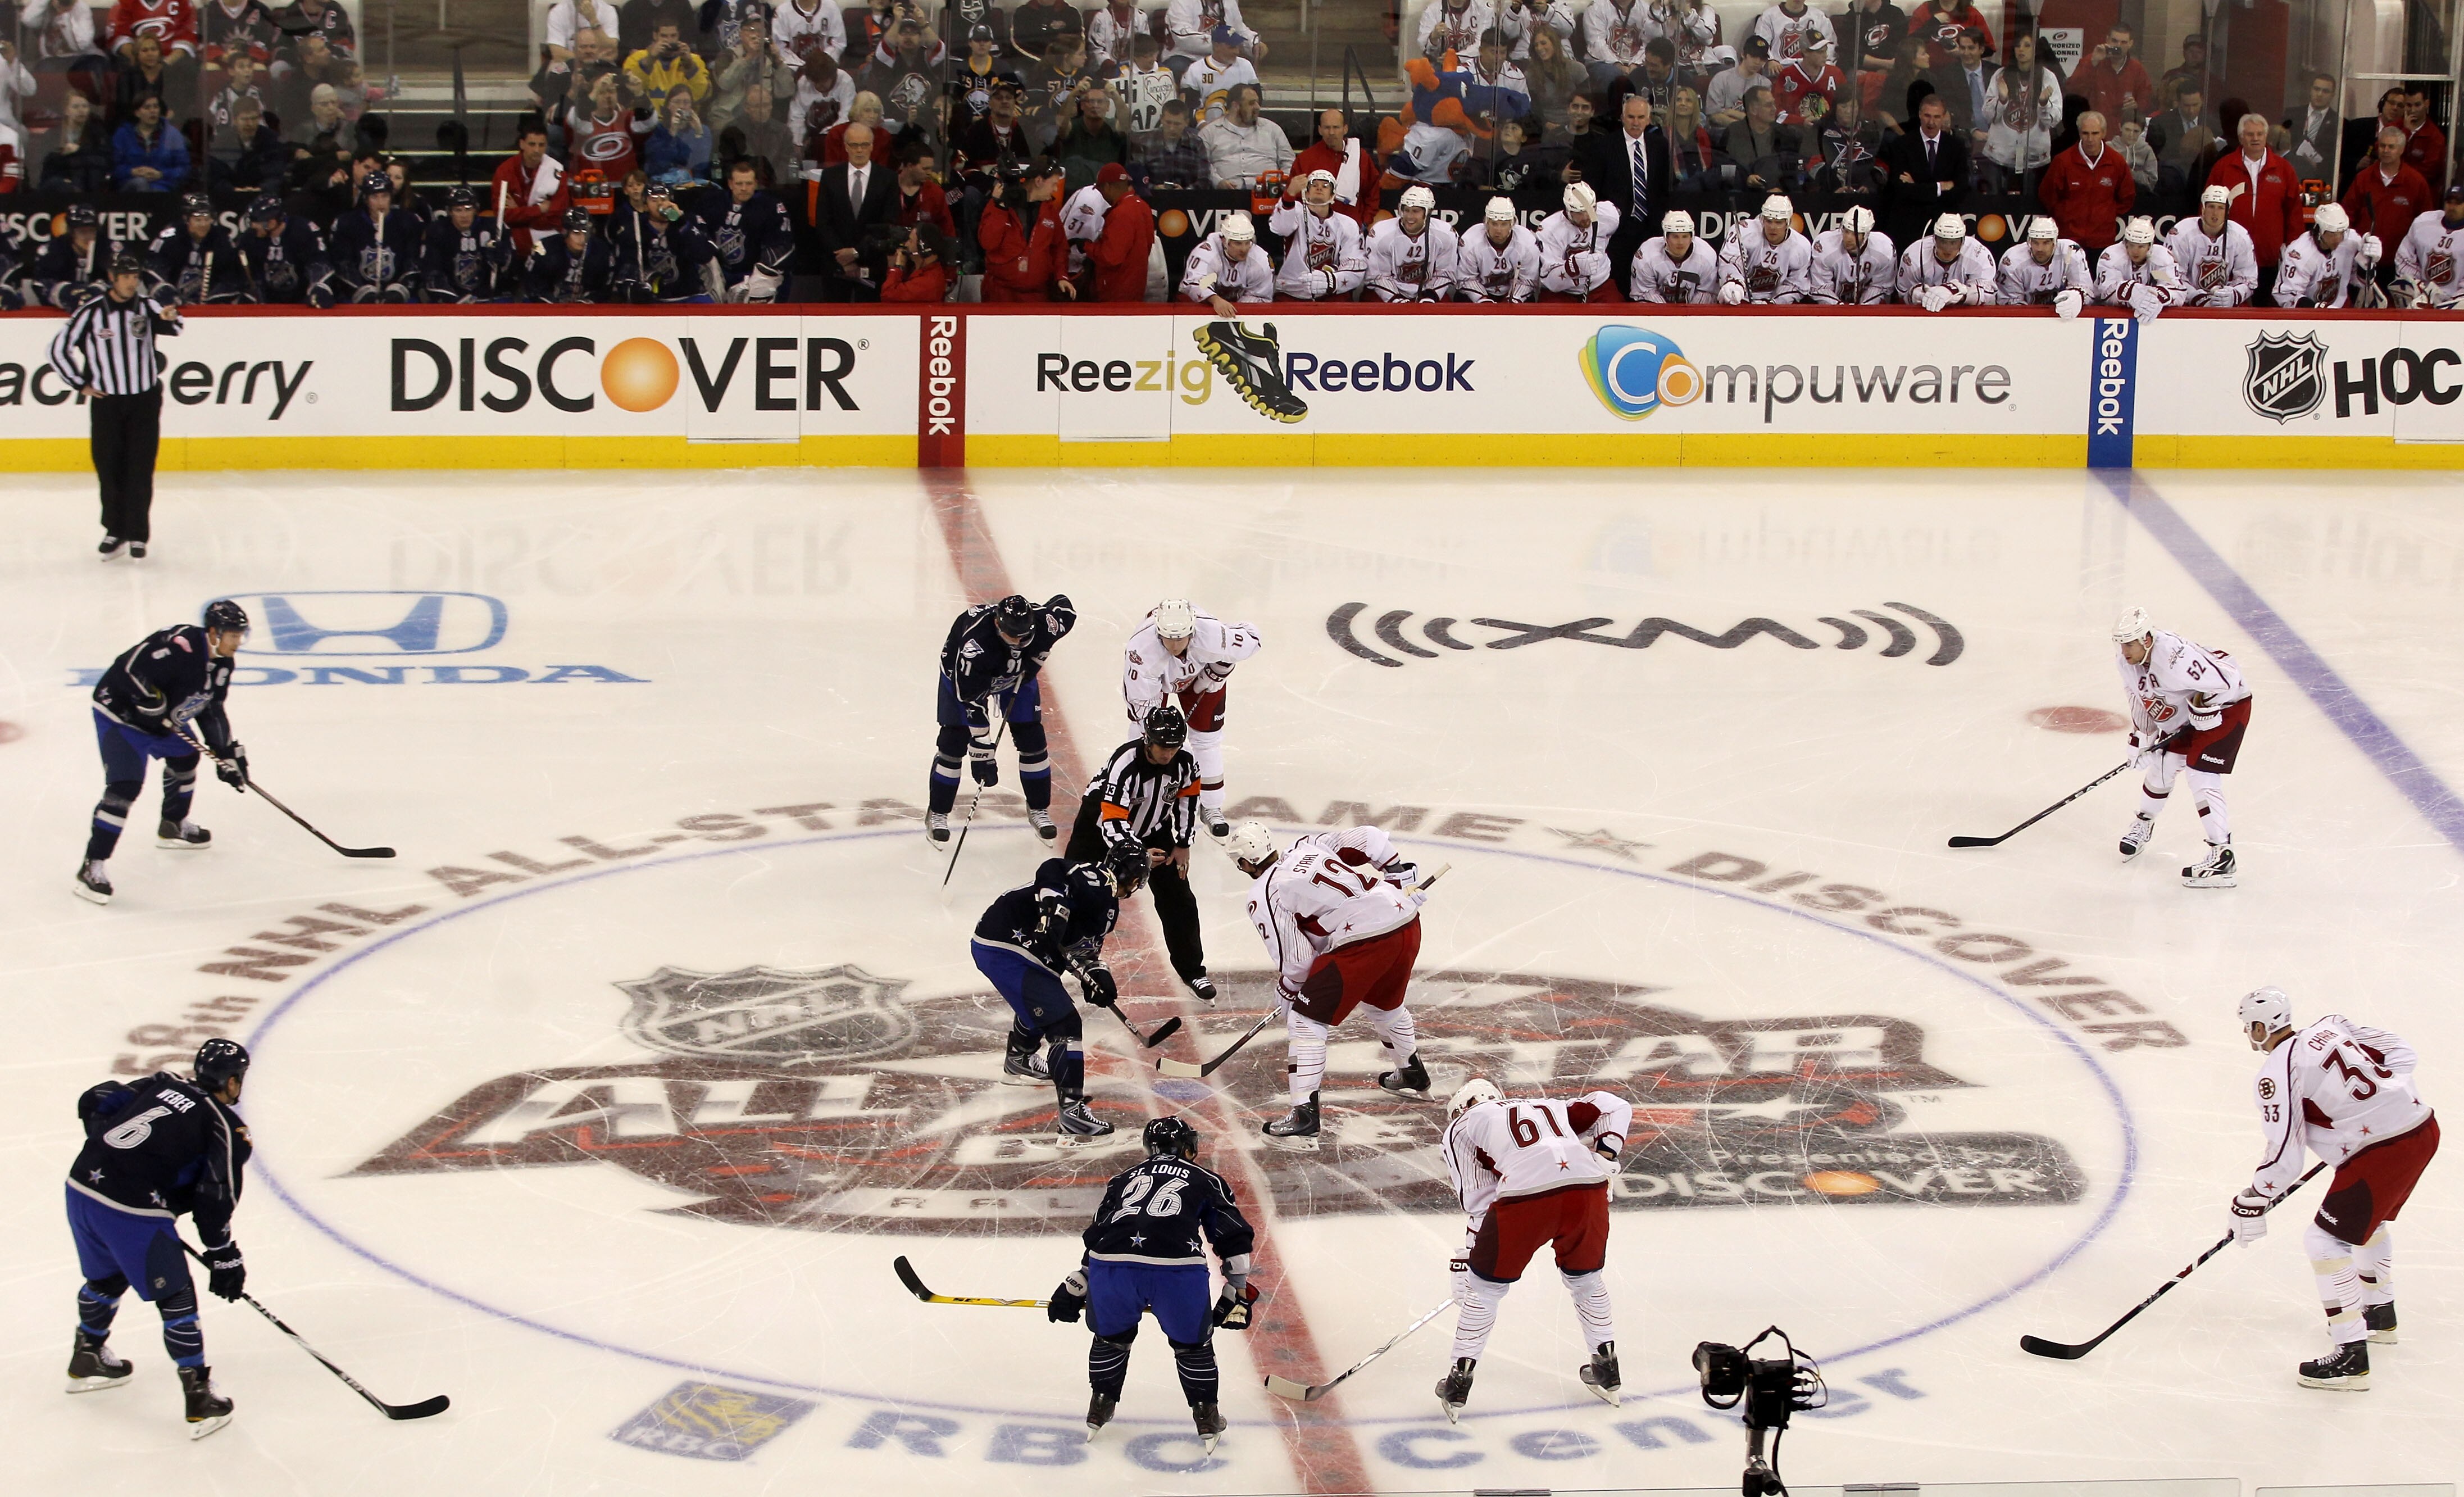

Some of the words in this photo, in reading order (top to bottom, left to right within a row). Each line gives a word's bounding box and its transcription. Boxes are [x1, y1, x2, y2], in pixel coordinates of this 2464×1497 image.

[1470, 16, 1477, 28] C
[1202, 73, 1213, 84] 30
[1827, 76, 1836, 91] A
[1116, 80, 1137, 103] Hi
[1068, 218, 1084, 234] 31
[1318, 226, 1330, 237] 26
[1574, 232, 1589, 243] 22
[2438, 236, 2453, 250] 30
[1311, 248, 1334, 266] NHL
[1407, 246, 1422, 258] 42
[1763, 251, 1777, 265] 26
[2207, 245, 2219, 256] 18
[1188, 255, 1201, 269] 10
[1494, 257, 1507, 269] 28
[1863, 262, 1871, 273] A
[2430, 260, 2451, 277] NHL
[2040, 273, 2053, 285] 22
[392, 337, 860, 412] DISCOVER
[928, 315, 957, 436] Reebok
[1038, 351, 1212, 406] Reezig
[1285, 352, 1475, 392] Reebok
[2097, 318, 2129, 436] Reebok
[2262, 358, 2310, 402] NHL
[1607, 342, 2012, 424] Compuware
[2334, 347, 2462, 418] HOC
[1232, 633, 1244, 648] 10
[1006, 658, 1022, 673] 91
[1128, 665, 1138, 681] 10
[1181, 663, 1195, 676] 10
[2186, 659, 2207, 681] 52
[66, 665, 652, 686] ONDA
[2149, 673, 2161, 688] A
[2149, 701, 2165, 719] NHL
[2201, 753, 2226, 766] Reebok
[1293, 853, 1319, 874] STAAL
[1310, 858, 1380, 900] 12
[197, 901, 431, 982] NHL
[425, 792, 1027, 897] ALL-STAR
[1225, 795, 1525, 842] AME
[1668, 851, 2190, 1054] DISCOVER
[156, 1088, 197, 1114] WEBER
[1908, 1095, 1942, 1103] TM
[2263, 1104, 2280, 1123] 33
[103, 1105, 173, 1149] 6
[1506, 1104, 1567, 1150] 61
[1707, 1149, 1945, 1165] Presented
[1129, 1167, 1147, 1179] ST.
[1151, 1164, 1191, 1179] LOUIS
[1613, 1167, 2048, 1198] DISCOVER
[1111, 1174, 1190, 1224] 26
[629, 1426, 742, 1460] RBC
[844, 1409, 1230, 1474] RBC
